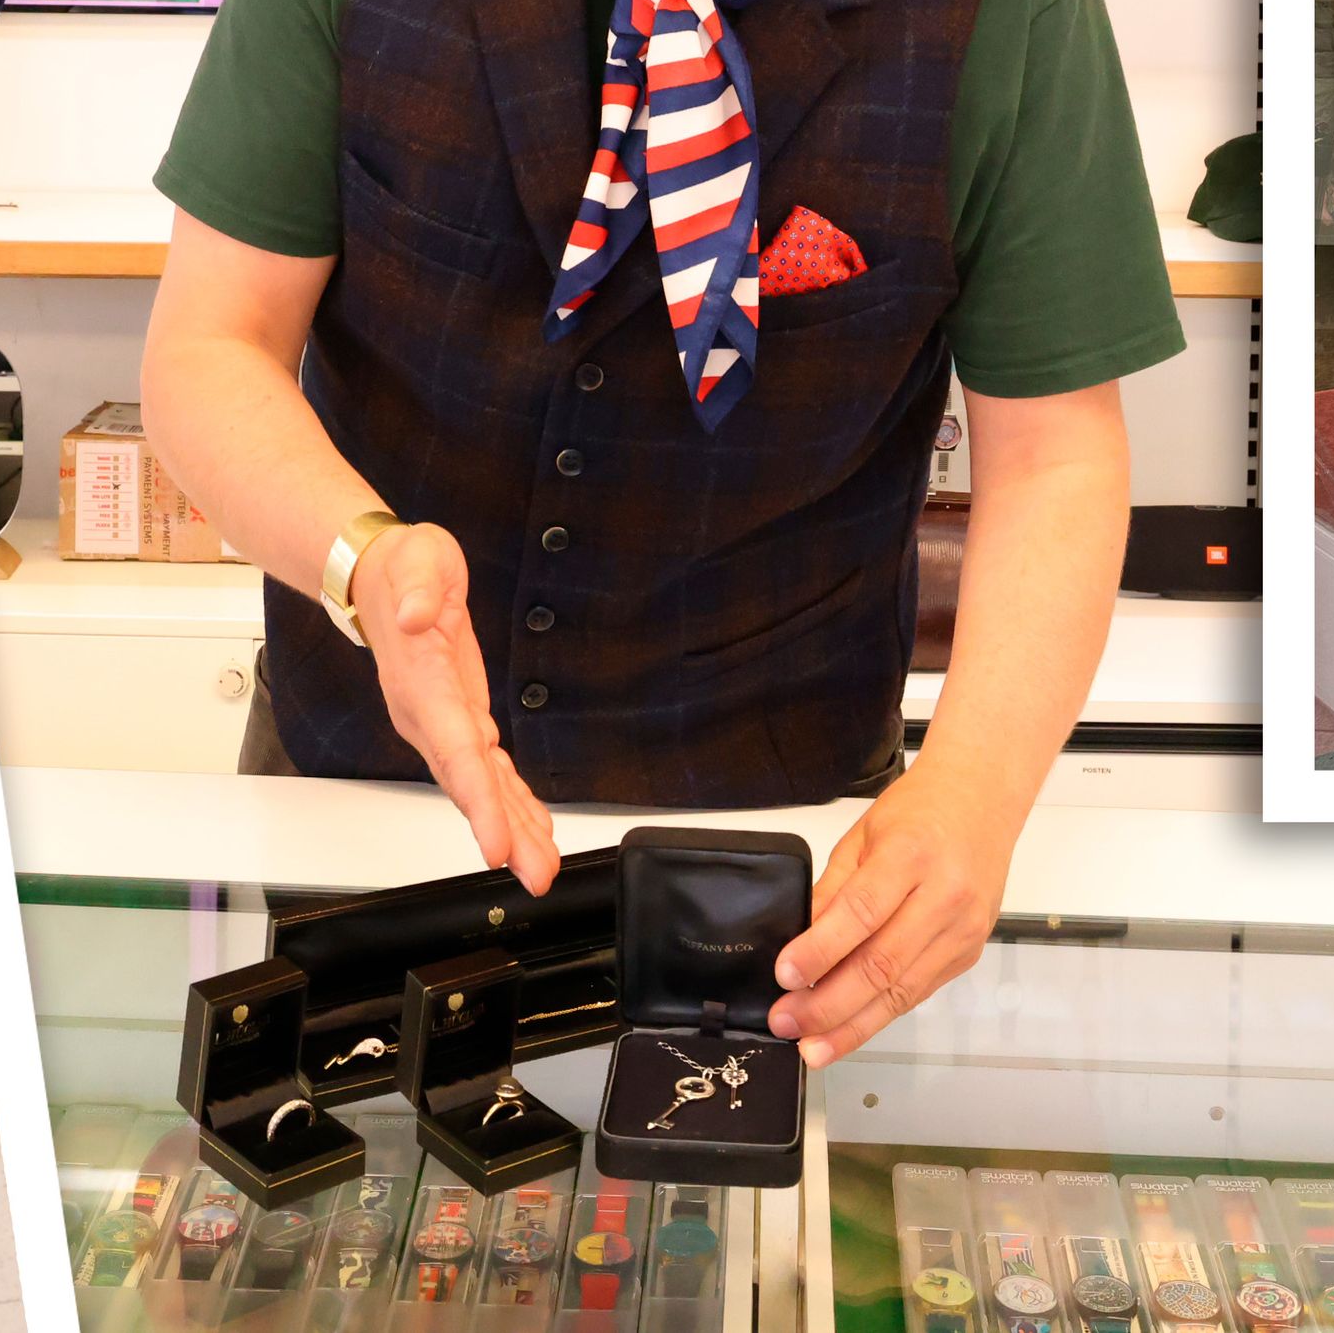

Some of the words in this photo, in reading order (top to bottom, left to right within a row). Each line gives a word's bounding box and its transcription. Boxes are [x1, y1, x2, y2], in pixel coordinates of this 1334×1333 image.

[143, 456, 153, 500] PAYMENT
[143, 503, 153, 545] SYSTEMS
[980, 1172, 1034, 1182] swatch
[1055, 1174, 1110, 1183] swatch
[1207, 1179, 1262, 1188] swatch
